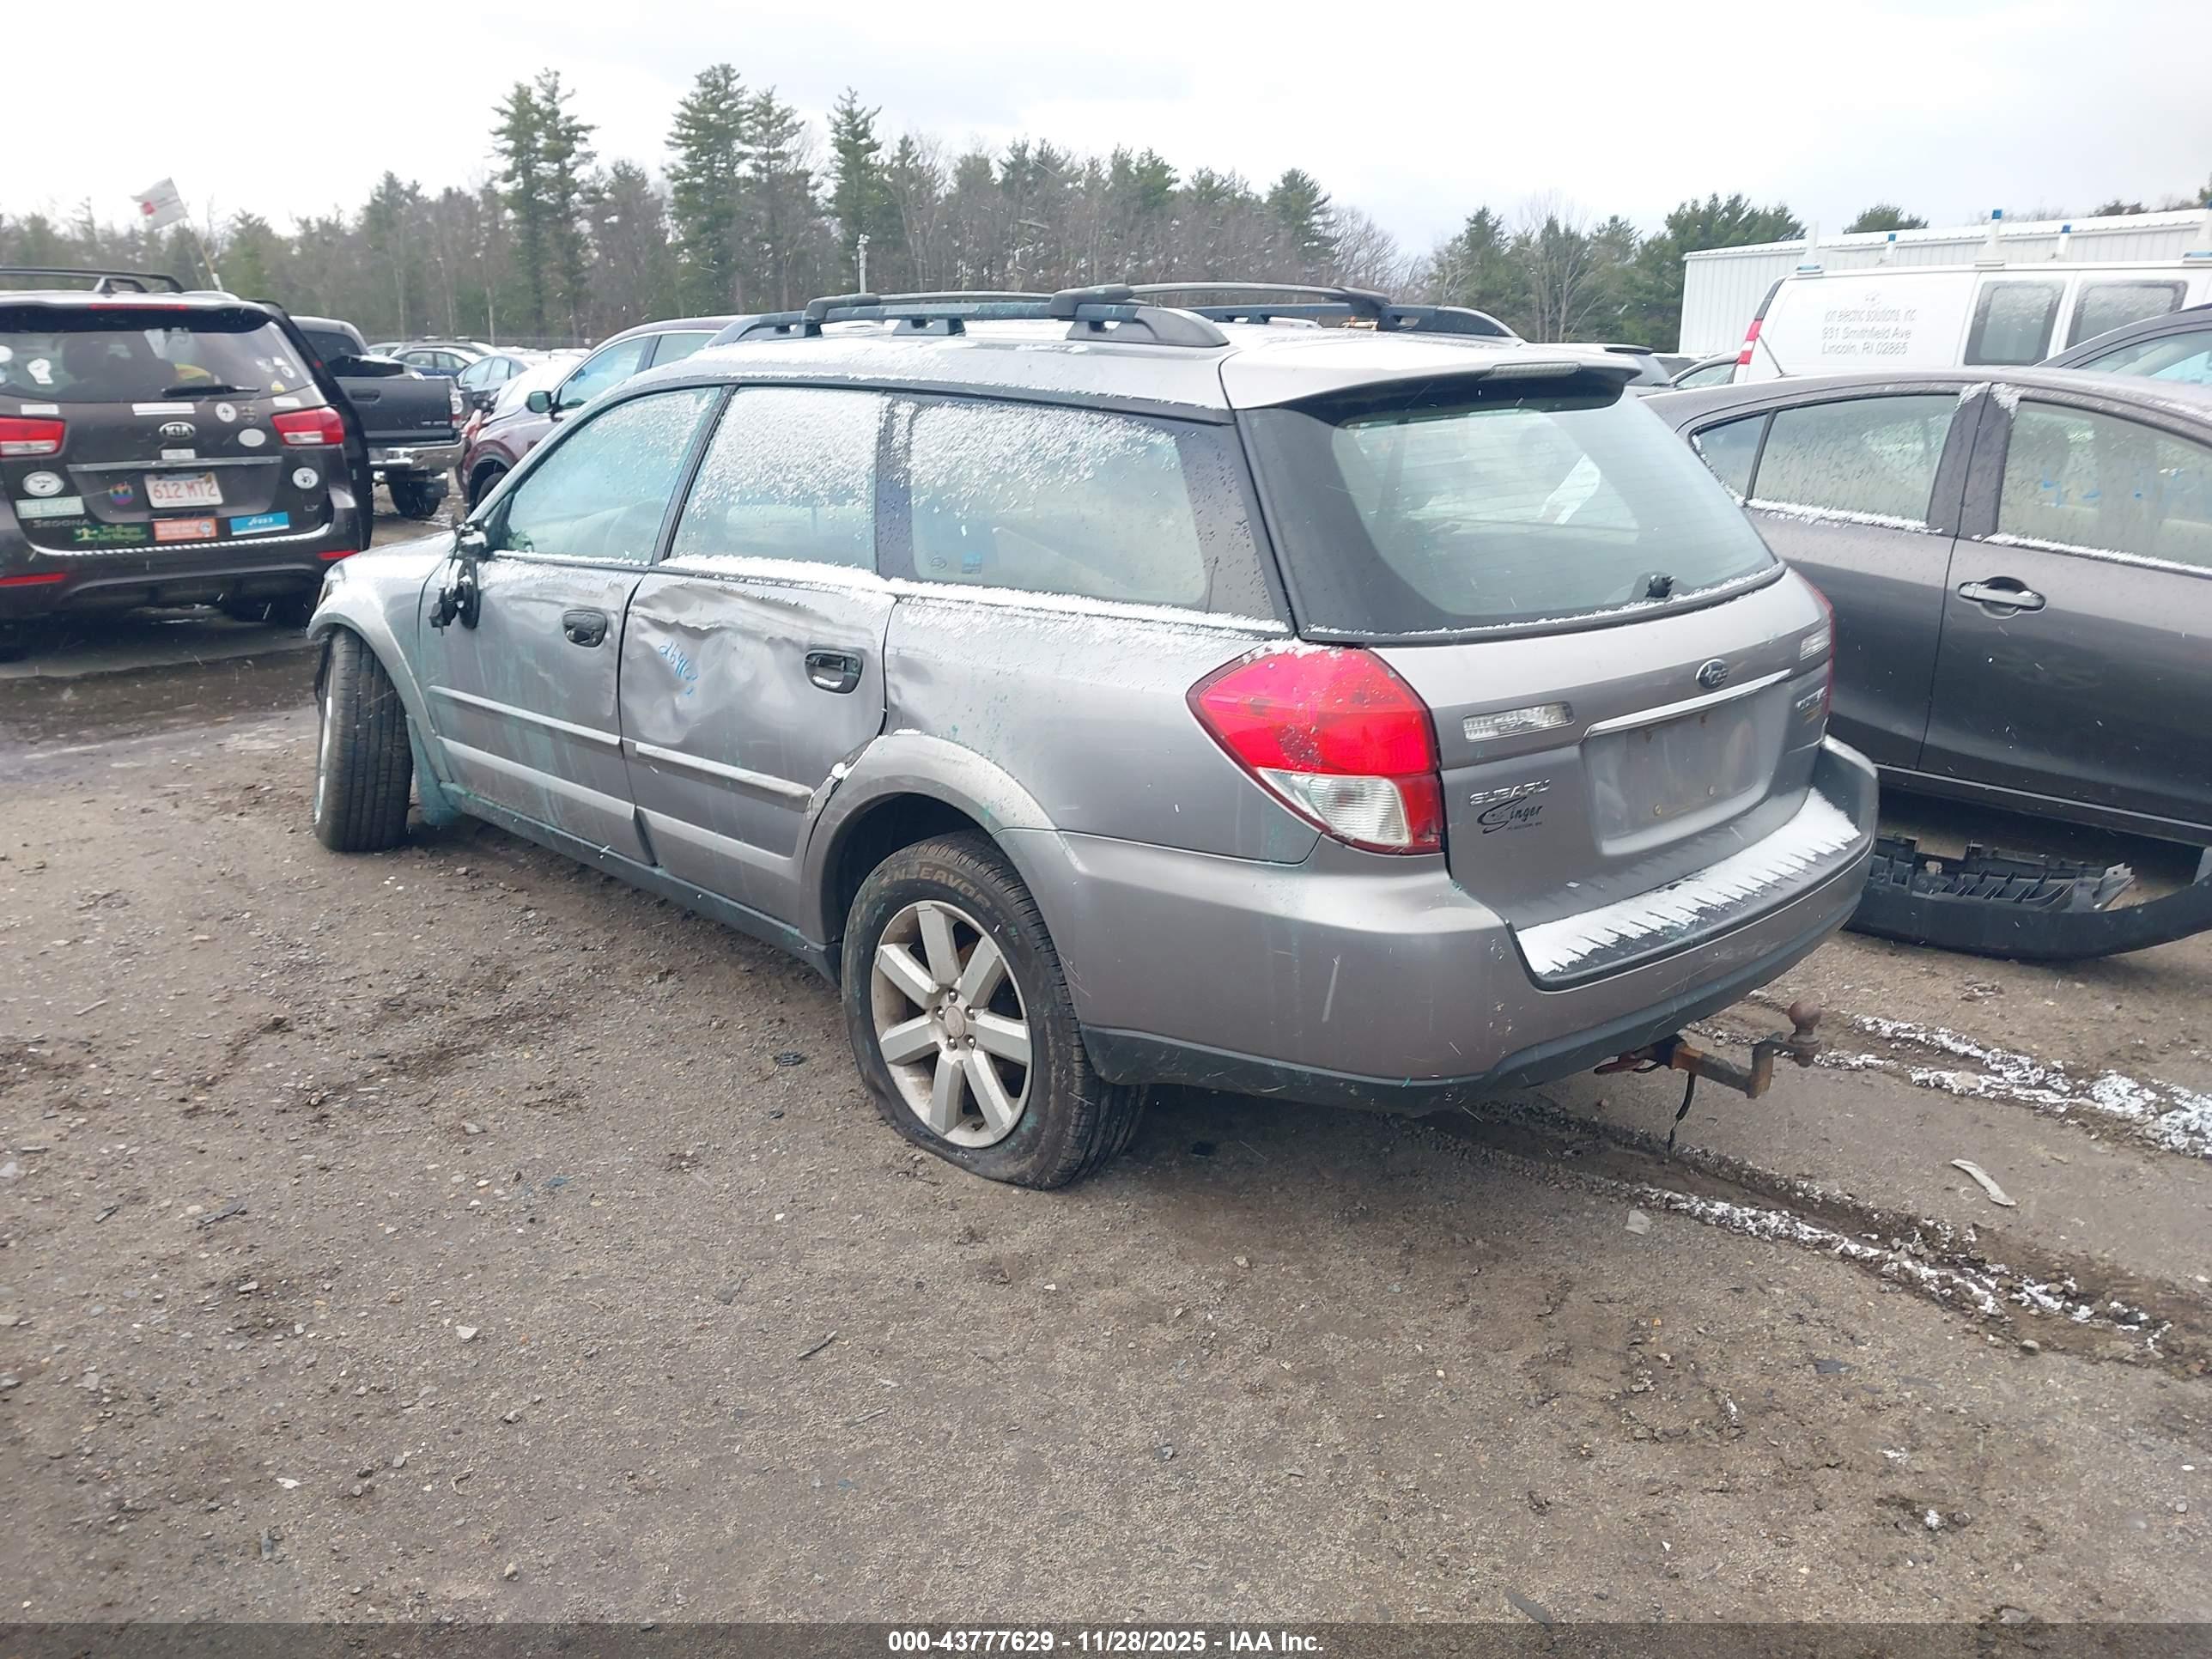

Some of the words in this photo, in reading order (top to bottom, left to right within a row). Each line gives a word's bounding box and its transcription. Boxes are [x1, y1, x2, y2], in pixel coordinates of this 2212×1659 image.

[1821, 326, 1839, 340] 931
[1842, 326, 1890, 340] Smithfield
[1892, 326, 1911, 339] Ave
[1862, 343, 1874, 355] RI
[153, 482, 183, 500] 612
[1469, 779, 1552, 806] SUBARU
[878, 866, 992, 908] NEAVOR
